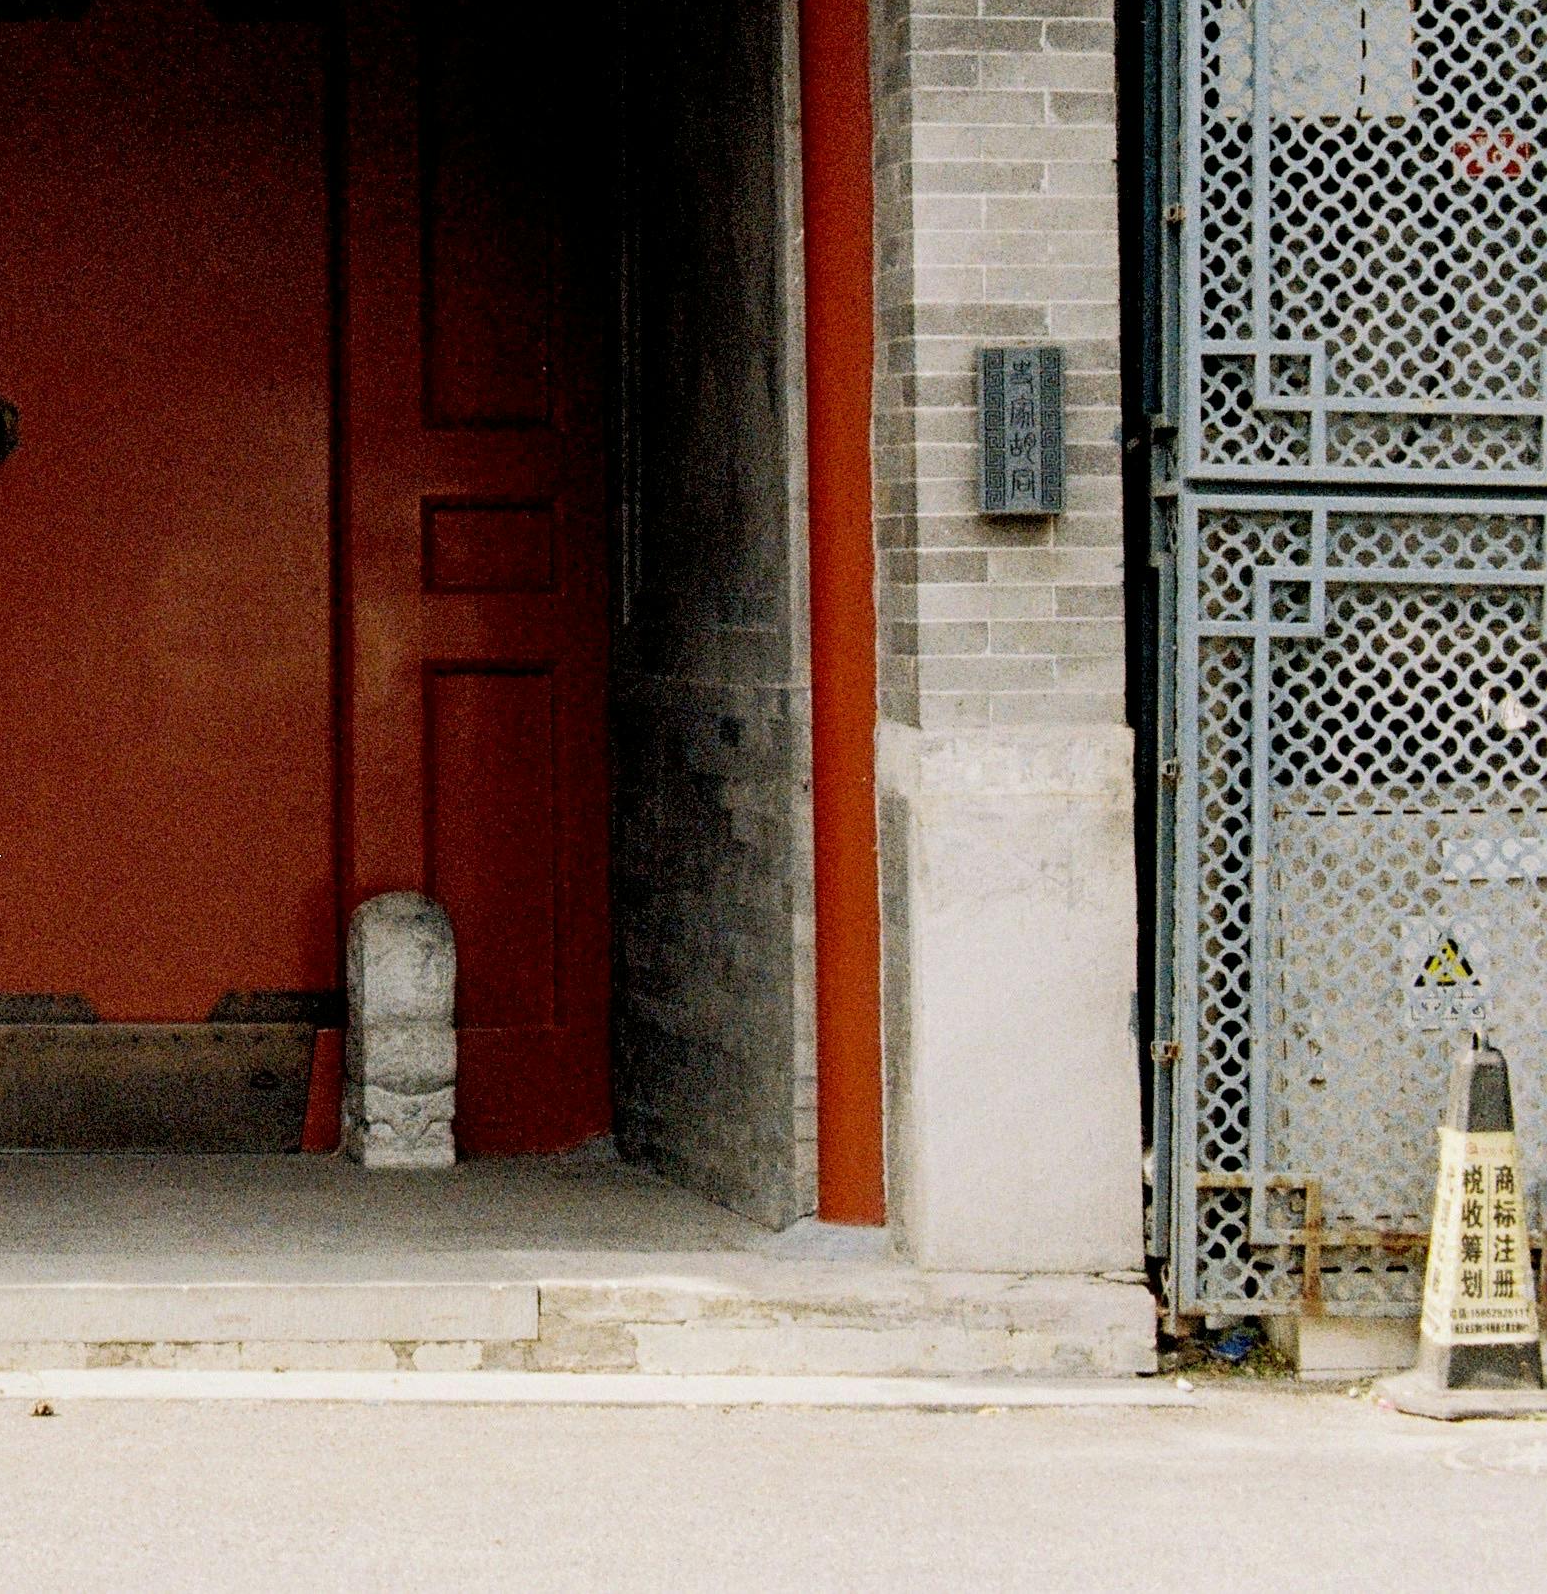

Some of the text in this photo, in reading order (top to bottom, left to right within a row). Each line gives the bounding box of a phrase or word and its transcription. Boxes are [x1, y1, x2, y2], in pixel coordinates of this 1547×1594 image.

[1460, 1164, 1484, 1299] 税收筹划
[1493, 1165, 1516, 1299] 商标注册
